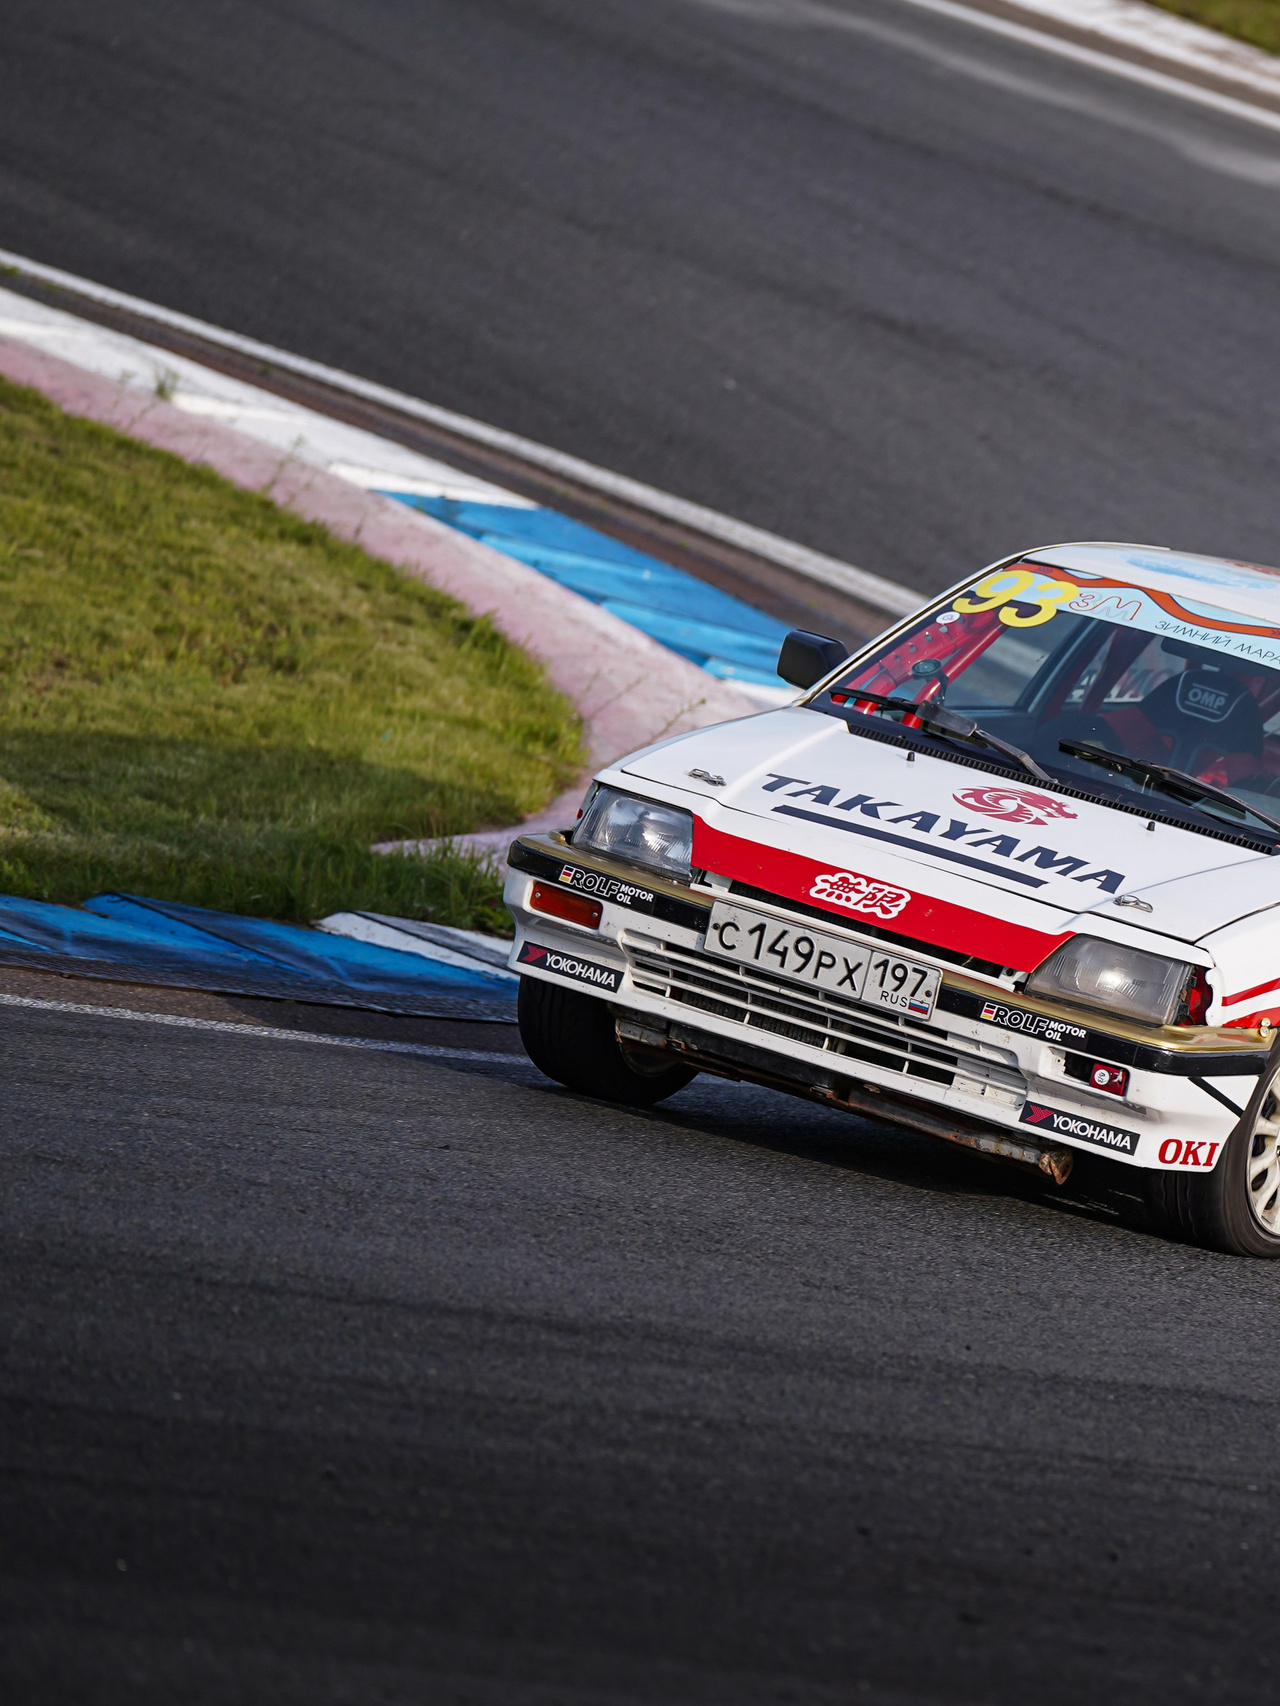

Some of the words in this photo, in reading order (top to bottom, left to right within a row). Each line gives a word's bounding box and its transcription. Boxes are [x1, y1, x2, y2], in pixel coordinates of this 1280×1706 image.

[952, 570, 1079, 627] 93
[1154, 620, 1232, 647] ЗИМНИЙ
[1187, 688, 1226, 709] OMP
[761, 773, 1126, 894] TAKAYAMA
[569, 869, 621, 898] ROLF
[619, 884, 654, 902] MOTOR
[809, 872, 912, 919] 無限
[616, 893, 632, 905] OIL
[545, 953, 617, 988] YOKOHAMA
[873, 958, 928, 998] 197
[879, 990, 909, 1008] RUS
[992, 1005, 1048, 1034] ROLF
[1047, 1020, 1087, 1039] MOTOR
[1045, 1029, 1062, 1042] OIL
[1051, 1113, 1132, 1150] YOKOHAMA
[1157, 1138, 1220, 1167] OKI
